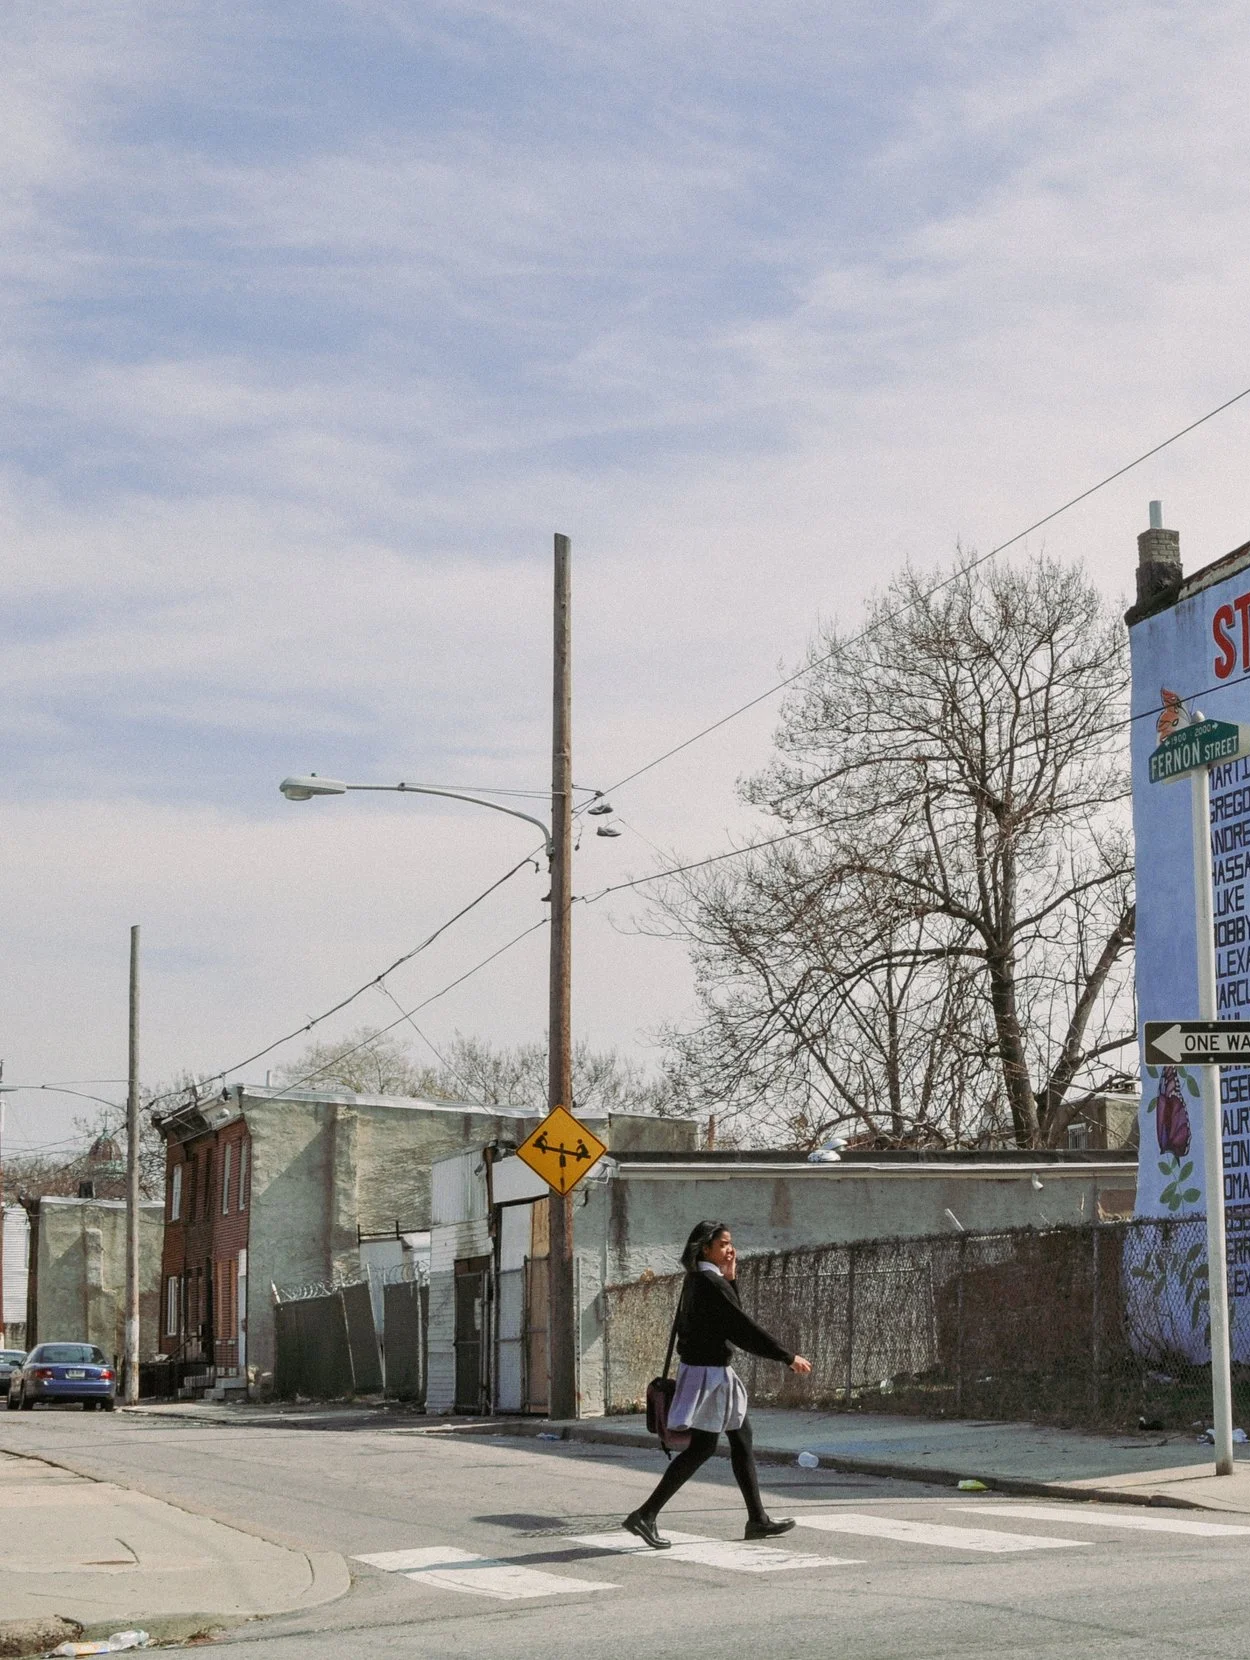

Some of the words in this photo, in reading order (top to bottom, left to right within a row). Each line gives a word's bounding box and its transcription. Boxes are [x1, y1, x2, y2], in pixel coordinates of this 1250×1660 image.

[1171, 732, 1187, 745] 1900
[1194, 724, 1211, 737] 2000
[1151, 738, 1200, 780] FERNON
[1204, 736, 1237, 760] STREET
[1213, 884, 1245, 917] UKE
[1185, 1034, 1219, 1050] ONE
[1223, 1139, 1249, 1168] EON
